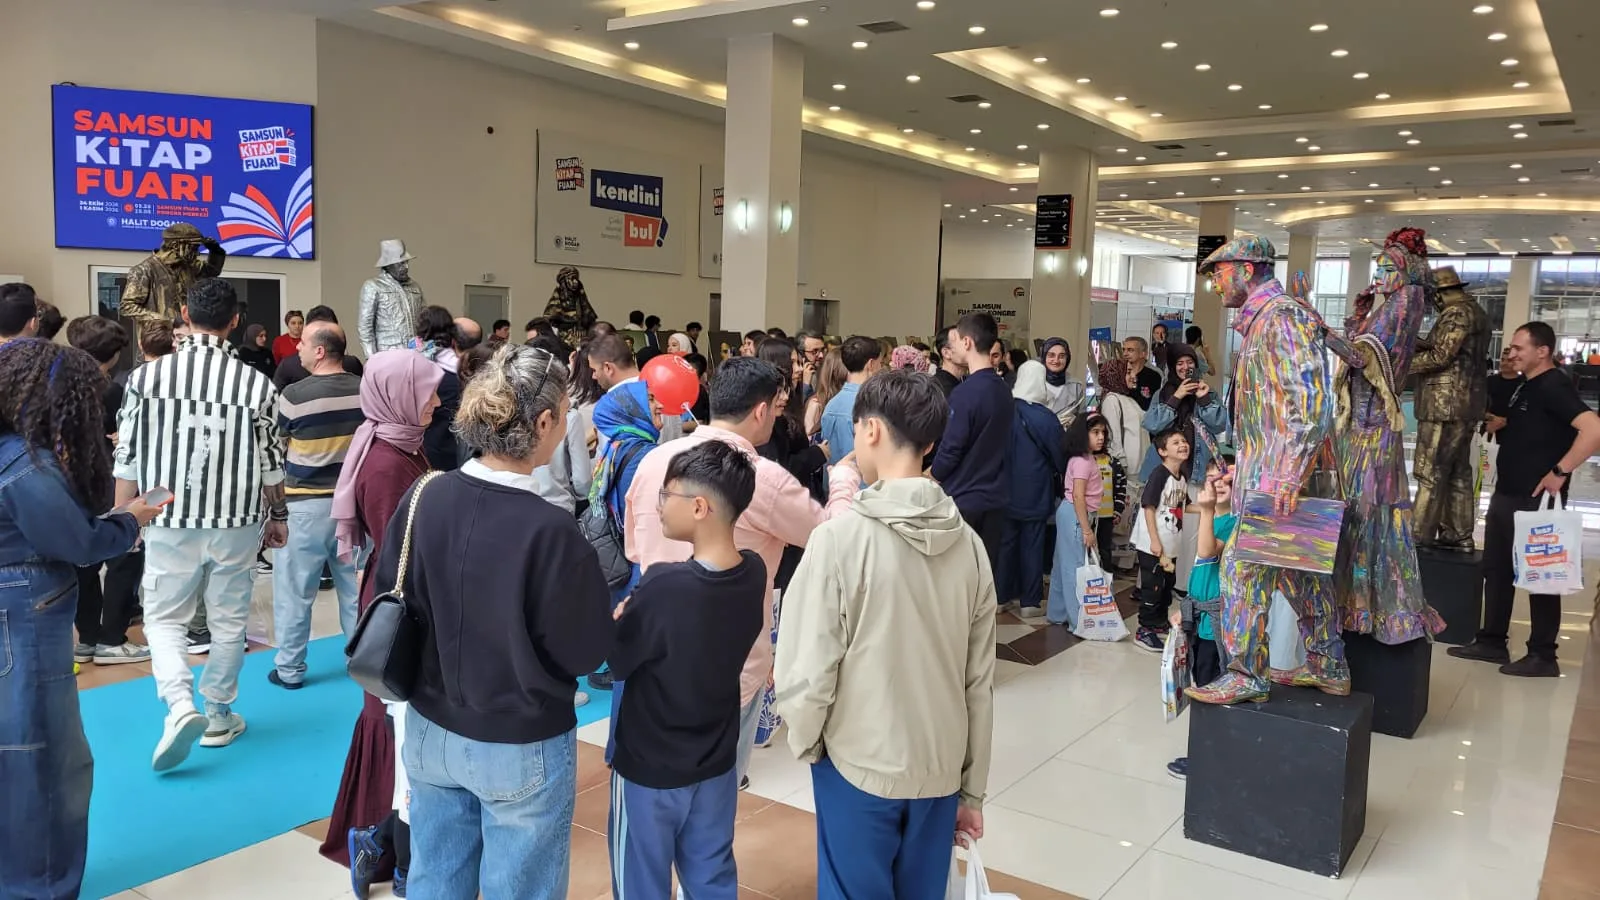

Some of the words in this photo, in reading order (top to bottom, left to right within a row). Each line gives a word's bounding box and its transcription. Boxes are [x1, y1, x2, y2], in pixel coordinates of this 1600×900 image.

[73, 109, 212, 140] SAMSUN
[242, 128, 283, 142] SAMSUN
[245, 156, 278, 169] FUARI
[76, 167, 213, 202] FUARI
[596, 177, 660, 207] kendini
[150, 219, 184, 228] DOĞA
